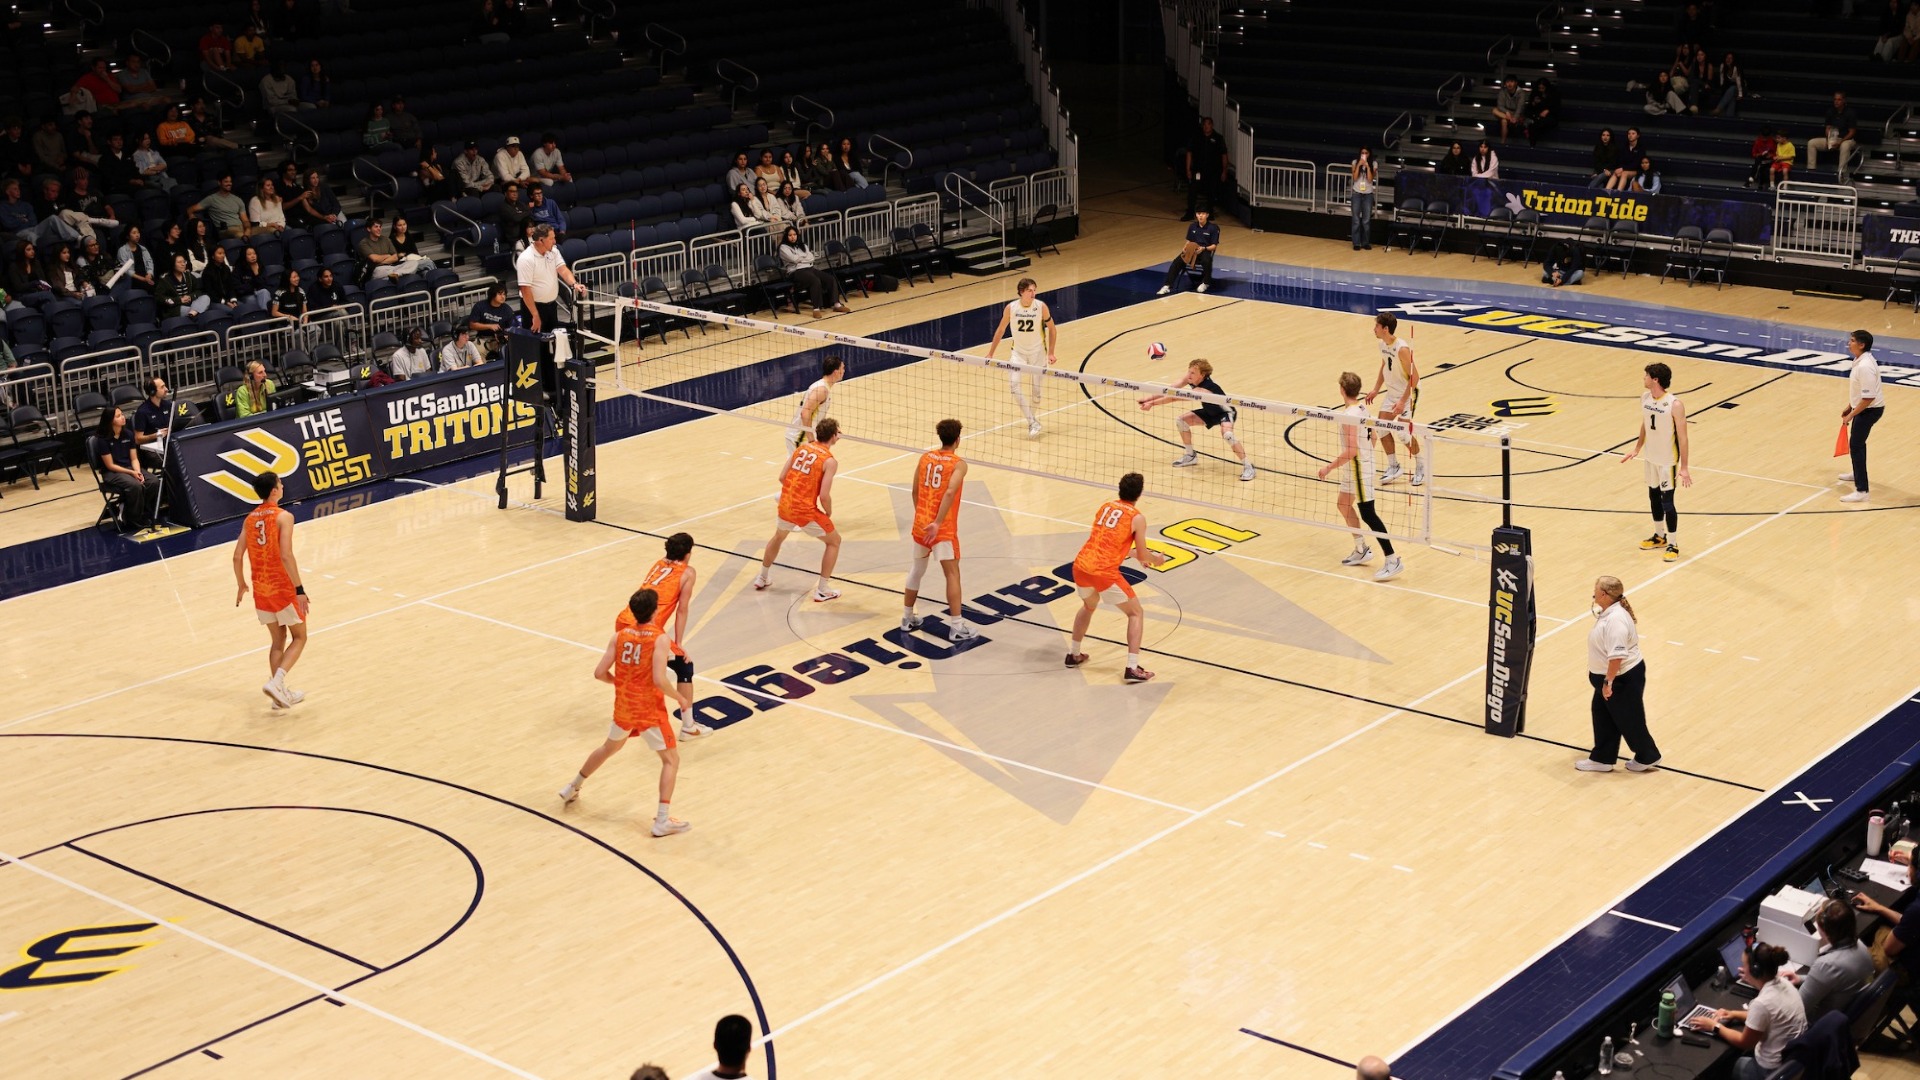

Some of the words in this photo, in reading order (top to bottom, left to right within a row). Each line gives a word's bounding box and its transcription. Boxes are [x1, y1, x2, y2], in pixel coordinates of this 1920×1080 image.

[1523, 189, 1593, 216] Triton
[1595, 196, 1649, 222] Tide
[1017, 319, 1034, 332] 22
[387, 382, 513, 425] UCSanDie
[293, 408, 347, 440] THE
[383, 401, 537, 460] TRITONS
[1650, 414, 1656, 430] 1
[302, 434, 349, 467] BIG
[791, 449, 818, 474] 22
[308, 453, 373, 491] WEST
[924, 462, 944, 489] 16
[1097, 506, 1124, 529] 18
[255, 520, 267, 546] 3
[643, 565, 673, 586] 17
[673, 517, 1261, 731] UCanDiego
[621, 642, 642, 665] 24
[1487, 589, 1514, 724] UCSanDiego
